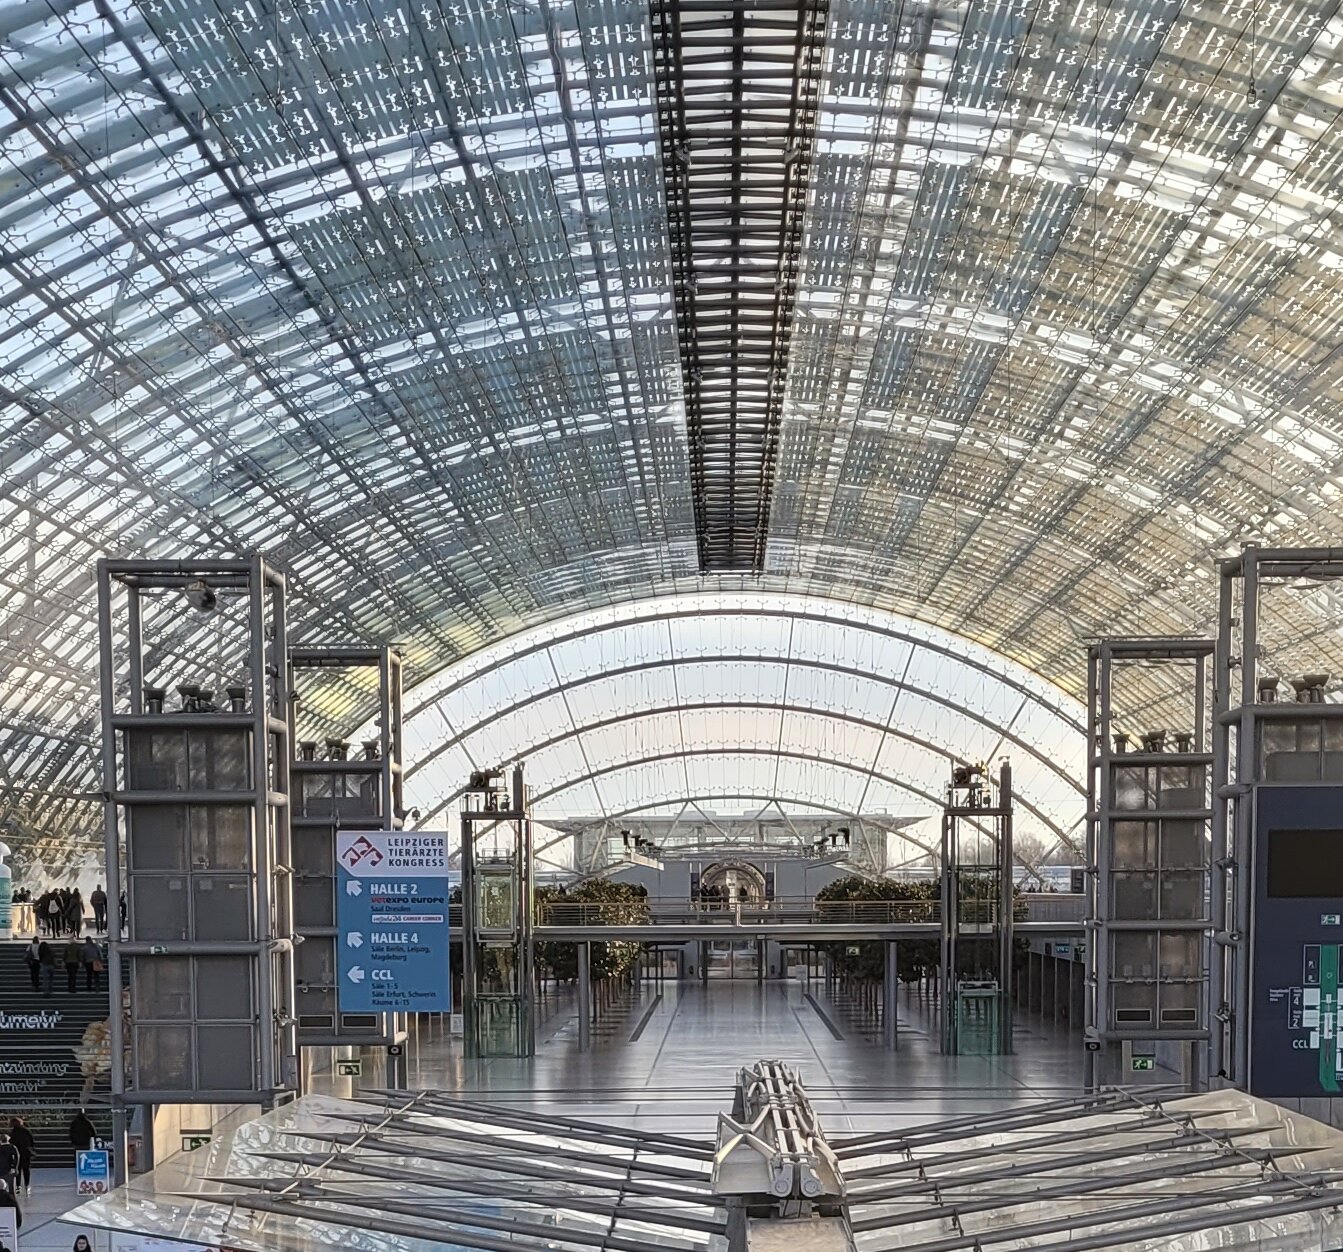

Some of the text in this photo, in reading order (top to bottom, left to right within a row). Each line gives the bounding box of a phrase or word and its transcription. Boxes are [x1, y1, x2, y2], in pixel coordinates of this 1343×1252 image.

[387, 838, 444, 847] LEIPZIGER
[388, 846, 444, 857] TIERÄRZTE
[388, 858, 445, 867] KONGRESS
[370, 883, 418, 895] HALLE 2
[370, 932, 419, 944] HALLE 4
[371, 969, 394, 980] CCL
[1292, 1040, 1309, 1049] CCL
